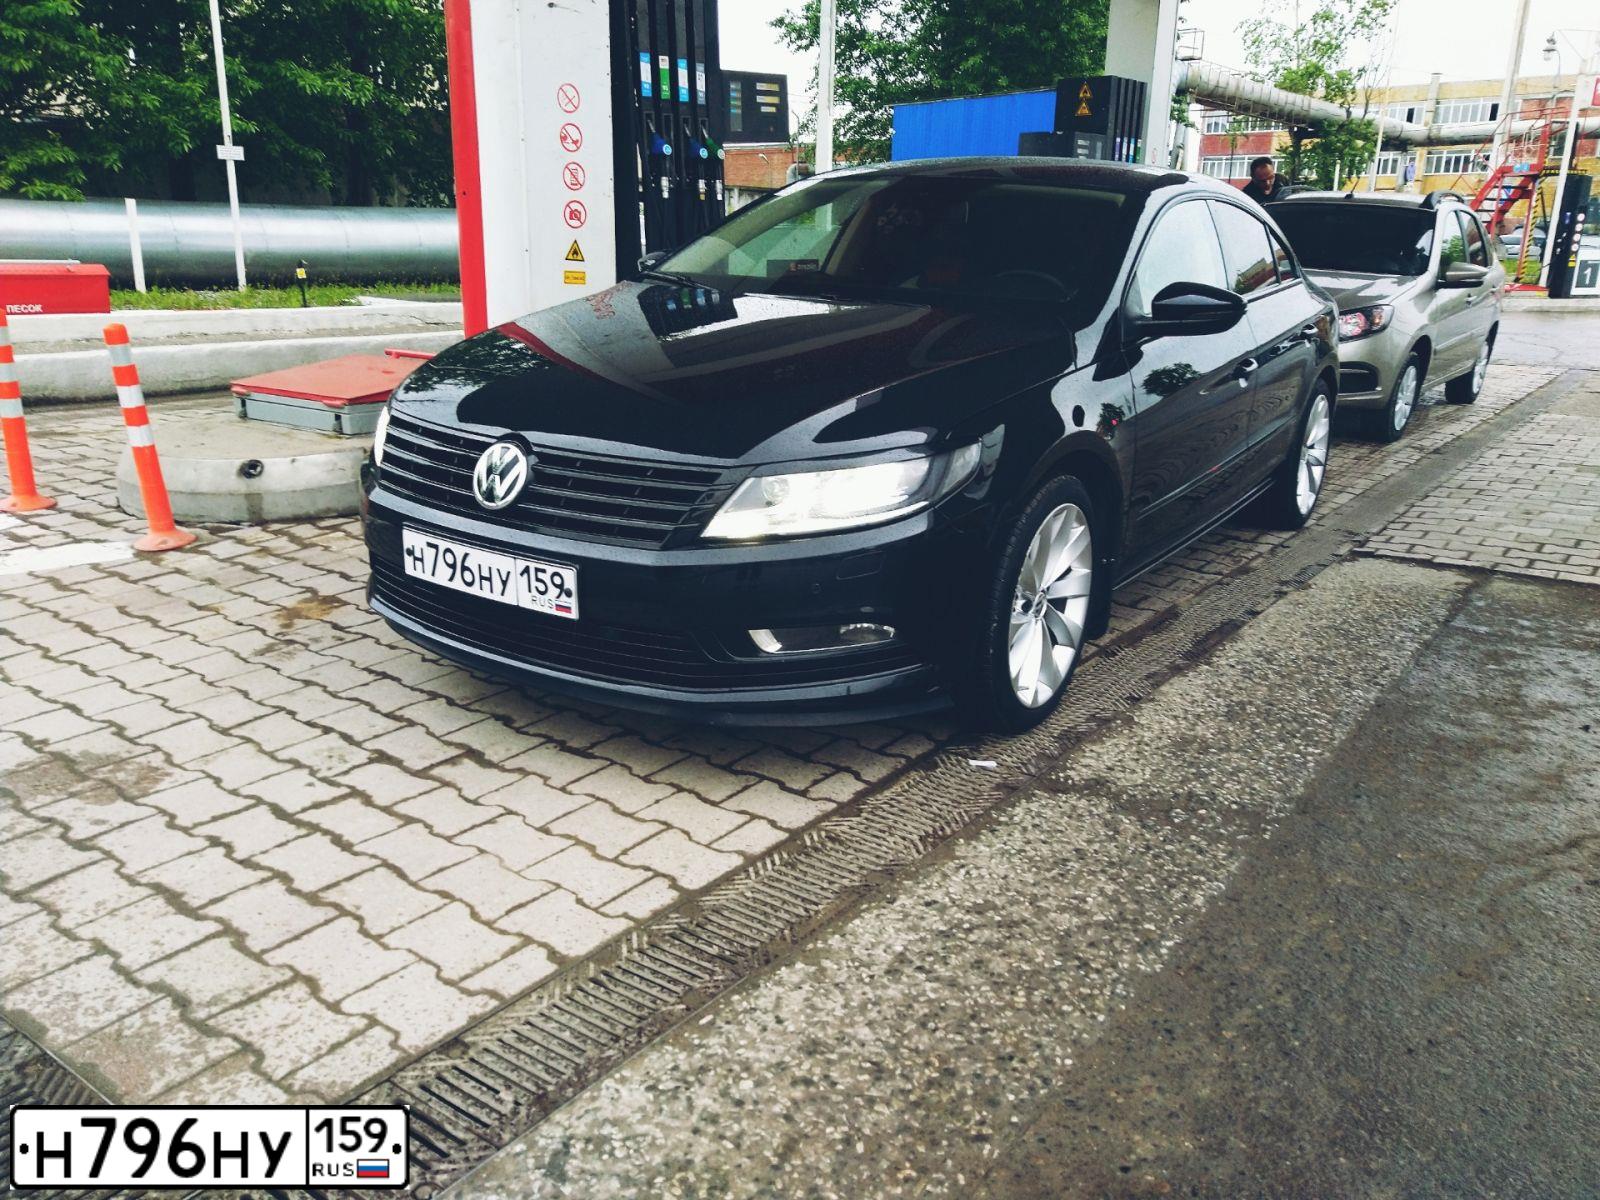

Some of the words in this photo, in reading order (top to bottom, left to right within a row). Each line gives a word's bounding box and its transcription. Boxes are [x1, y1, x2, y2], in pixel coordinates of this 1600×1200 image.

[6, 304, 43, 313] ПЕСОК
[519, 564, 565, 600] 159
[531, 595, 555, 609] RUS
